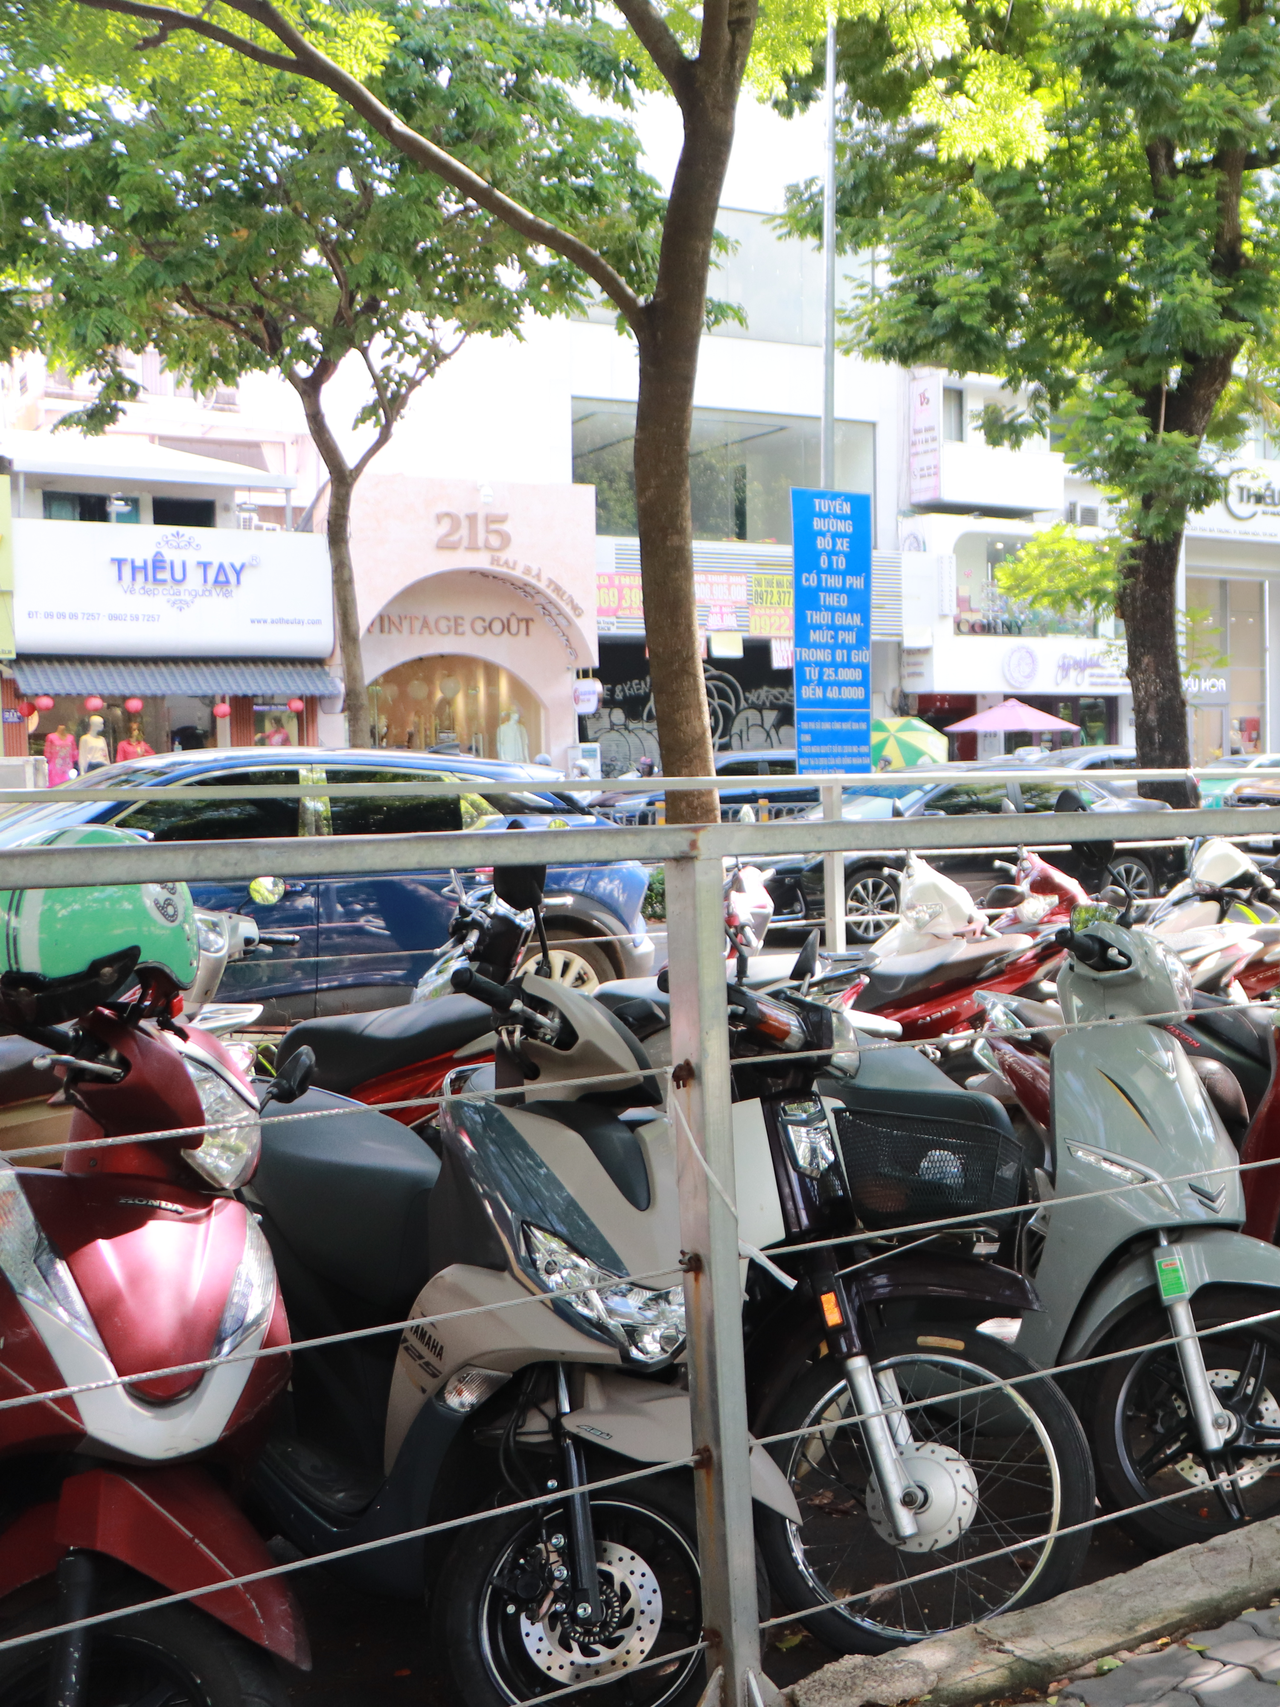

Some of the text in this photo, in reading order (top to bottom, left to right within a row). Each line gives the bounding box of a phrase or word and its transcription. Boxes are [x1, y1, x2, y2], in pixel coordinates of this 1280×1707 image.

[813, 496, 851, 514] TUYẾN
[436, 511, 512, 551] 215
[812, 515, 853, 533] ĐƯỜNG
[816, 533, 850, 551] ĐỖ XE
[110, 550, 246, 586] THÊU TAY
[490, 554, 518, 570] HAI
[522, 563, 542, 582] BÀ
[820, 552, 846, 569] Ô TÔ
[802, 570, 866, 589] CÓ THU PHÍ
[622, 588, 643, 607] 39
[694, 583, 746, 599] 906.905.006
[819, 592, 848, 606] THEO
[28, 610, 41, 620] ĐT:
[44, 611, 54, 620] 09
[56, 611, 67, 620] 09
[68, 611, 79, 621] 09
[81, 612, 101, 621] 7257
[108, 613, 128, 622] 0902
[129, 613, 140, 623] 59
[805, 607, 832, 625] THỜI
[810, 627, 857, 643] MỨC PHÍ
[795, 647, 869, 662] TRONG 01 GIỜ
[804, 664, 862, 681] TỪ 25.000Đ
[801, 681, 823, 699] ĐẾN
[826, 686, 865, 699] 40.000Đ
[1201, 678, 1226, 692] HOA
[119, 1196, 185, 1214] HONDA
